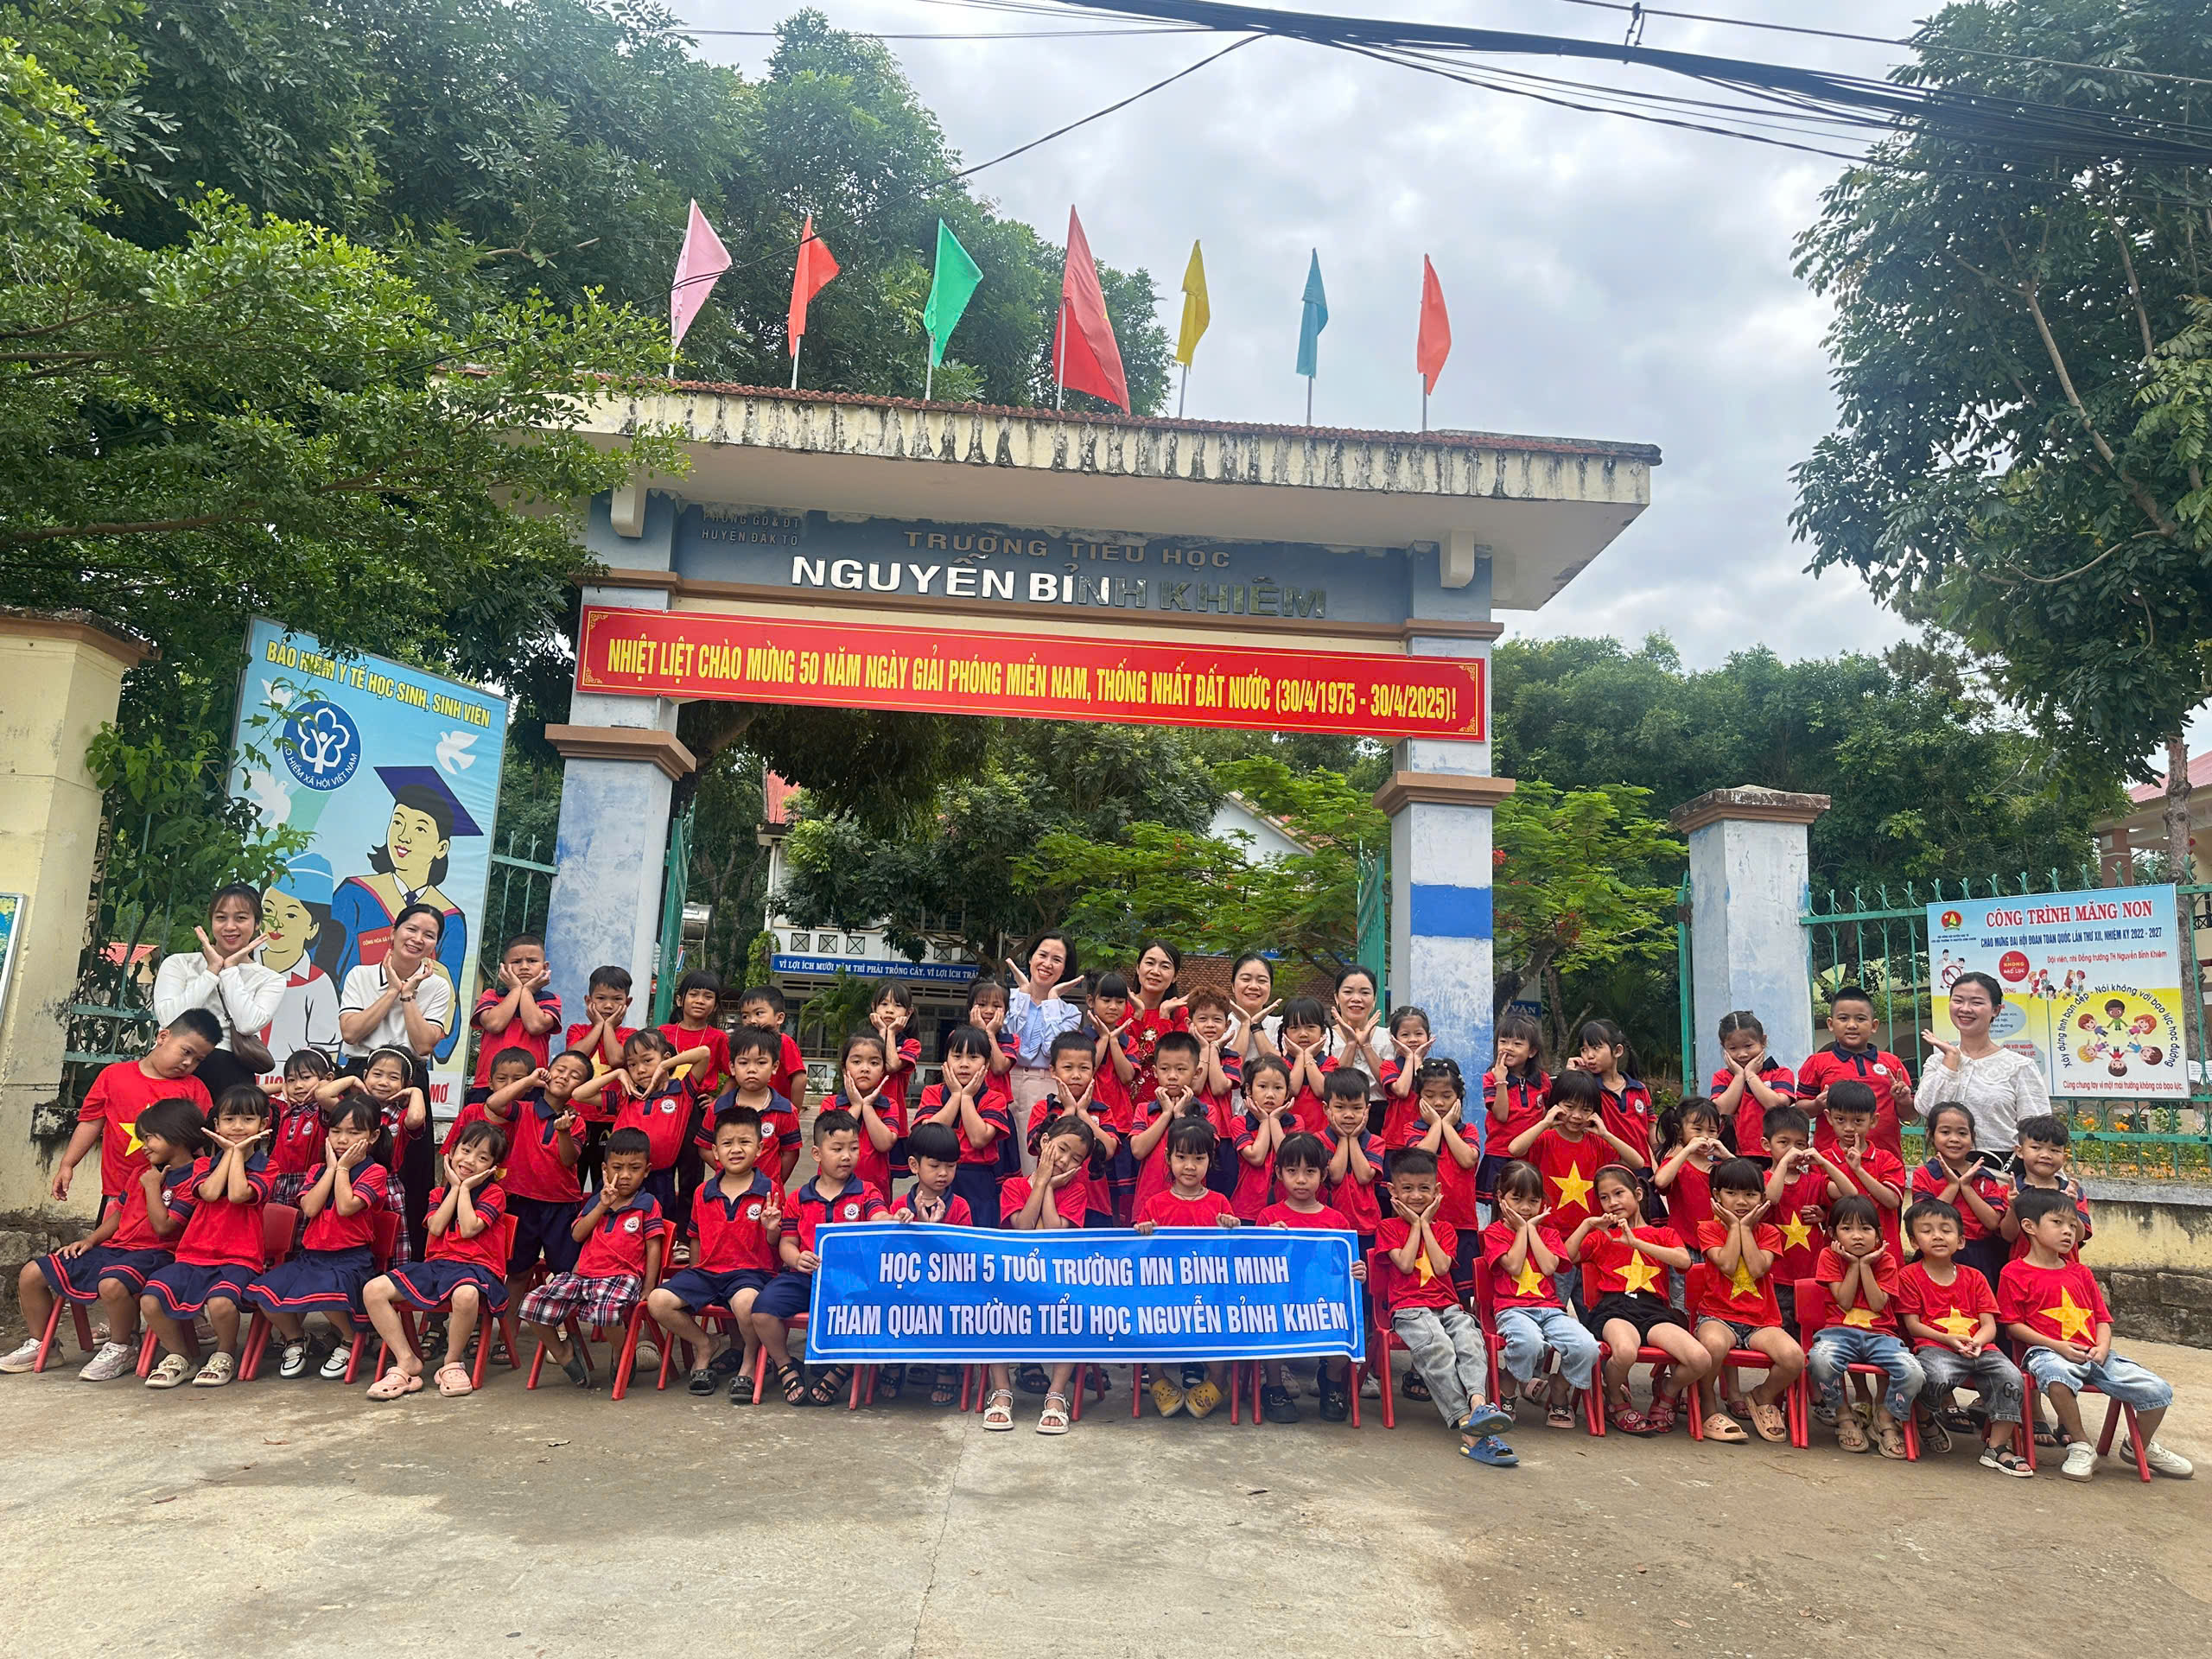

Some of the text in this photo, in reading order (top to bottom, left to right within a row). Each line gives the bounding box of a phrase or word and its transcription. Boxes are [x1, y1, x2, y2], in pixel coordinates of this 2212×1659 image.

[1161, 549, 1230, 571] HỌC
[791, 553, 1327, 618] NGUYỄN BỈNH KHIÊM
[265, 637, 298, 669] BẢO
[339, 661, 349, 684] Y
[349, 664, 369, 690] TẾ
[366, 671, 395, 700] HỌC
[396, 681, 429, 712] SINH,
[432, 692, 462, 720] SINH
[463, 702, 491, 728] VIÊN
[607, 633, 657, 682] NHIỆT
[659, 636, 695, 683] LIỆT
[698, 639, 742, 680] CHÀO
[746, 640, 795, 683] MỪNG
[799, 652, 819, 684] 50
[823, 646, 861, 687] NĂM
[865, 650, 909, 690] NGÀY
[912, 644, 944, 692] GIẢI
[948, 654, 1001, 695] PHÓNG
[1006, 652, 1047, 697] MIỀN
[1051, 665, 1091, 704] NAM,
[1096, 658, 1147, 703] THỐNG
[1151, 662, 1192, 706] NHẤT
[1195, 664, 1225, 708] ĐẤT
[1229, 668, 1271, 710] NƯỚC
[1275, 679, 1356, 715] (30/4/1975
[1370, 683, 1457, 723] 30/4/2025)!
[303, 774, 315, 785] XÃ
[315, 778, 330, 789] HỘI
[331, 772, 346, 785] VIỆT
[346, 753, 358, 773] NAM
[1986, 900, 2152, 927] CÔNG TRÌNH MĂNG NON
[2131, 928, 2144, 939] 2022
[2149, 927, 2162, 938] 2027
[779, 959, 787, 968] VÌ
[788, 961, 800, 970] LỢI
[802, 960, 815, 969] ÍCH
[816, 962, 835, 971] MƯỜI
[853, 963, 866, 973] THÌ
[867, 963, 883, 974] PHẢI
[885, 964, 908, 975] TRỒNG
[909, 967, 925, 977] CÂY,
[927, 968, 935, 976] VÌ
[936, 969, 947, 978] LỢI
[949, 968, 962, 978] ÍCH
[2094, 985, 2109, 994] Nói
[2111, 984, 2138, 996] không
[2139, 990, 2152, 1002] với
[2151, 998, 2165, 1014] bạo
[879, 1248, 1290, 1289] HỌC SINH 5 TUỔI TRƯỜNG MN BÌNH MINH
[827, 1293, 1350, 1341] THAM QUAN TRƯỜNG TIỂU HỌC NGUYỄN BỈNH KHIÊM
